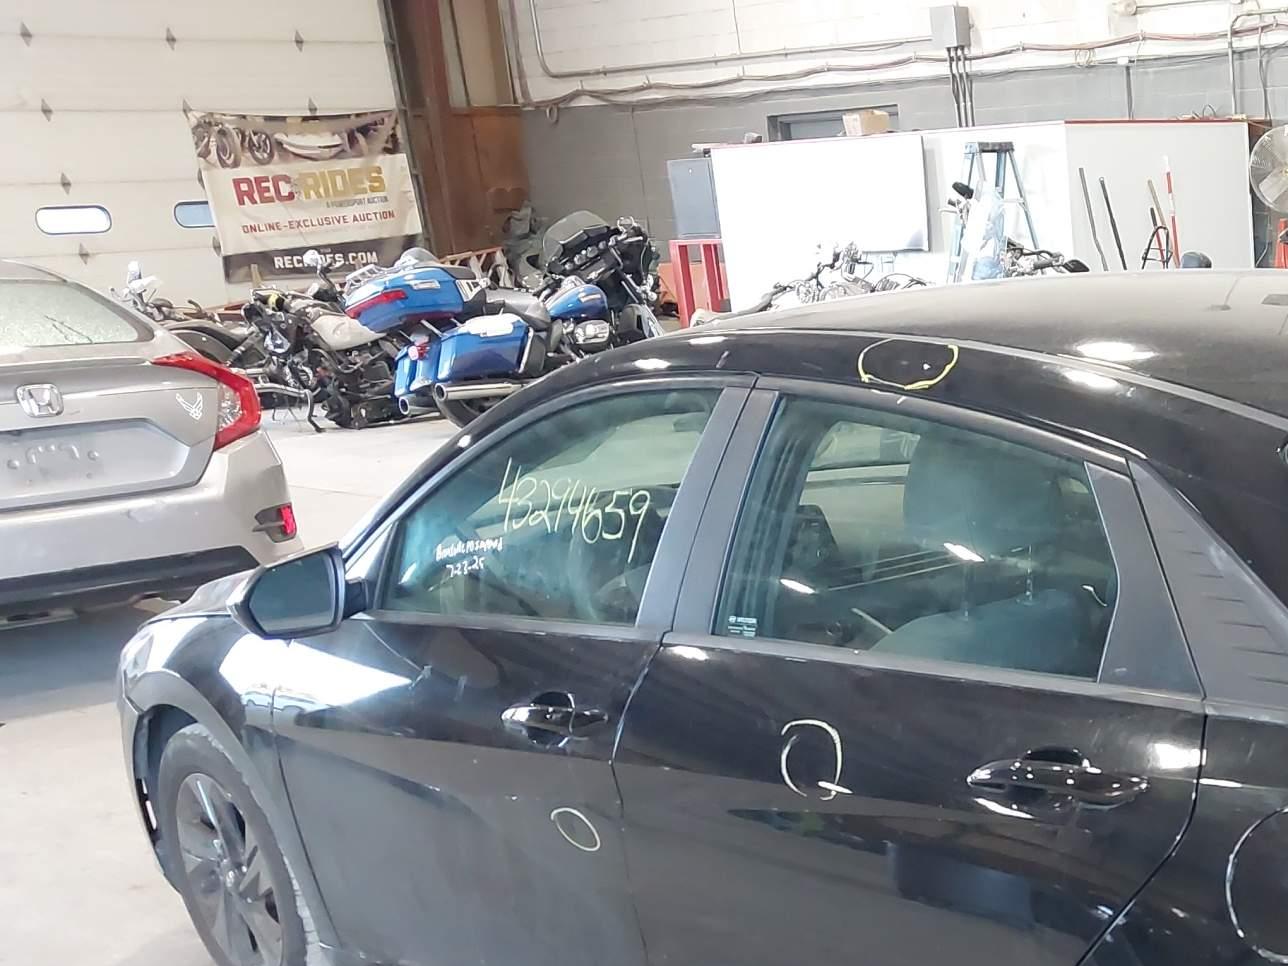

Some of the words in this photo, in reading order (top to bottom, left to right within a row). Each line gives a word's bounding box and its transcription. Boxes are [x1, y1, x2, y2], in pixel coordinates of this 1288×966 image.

[233, 174, 295, 206] REC
[297, 166, 386, 201] RIDES
[242, 215, 349, 234] ONLINE-EXCLUSIVE
[352, 210, 395, 224] AUCTION
[274, 251, 378, 269] RECDES.COM
[499, 457, 651, 564] 43294659
